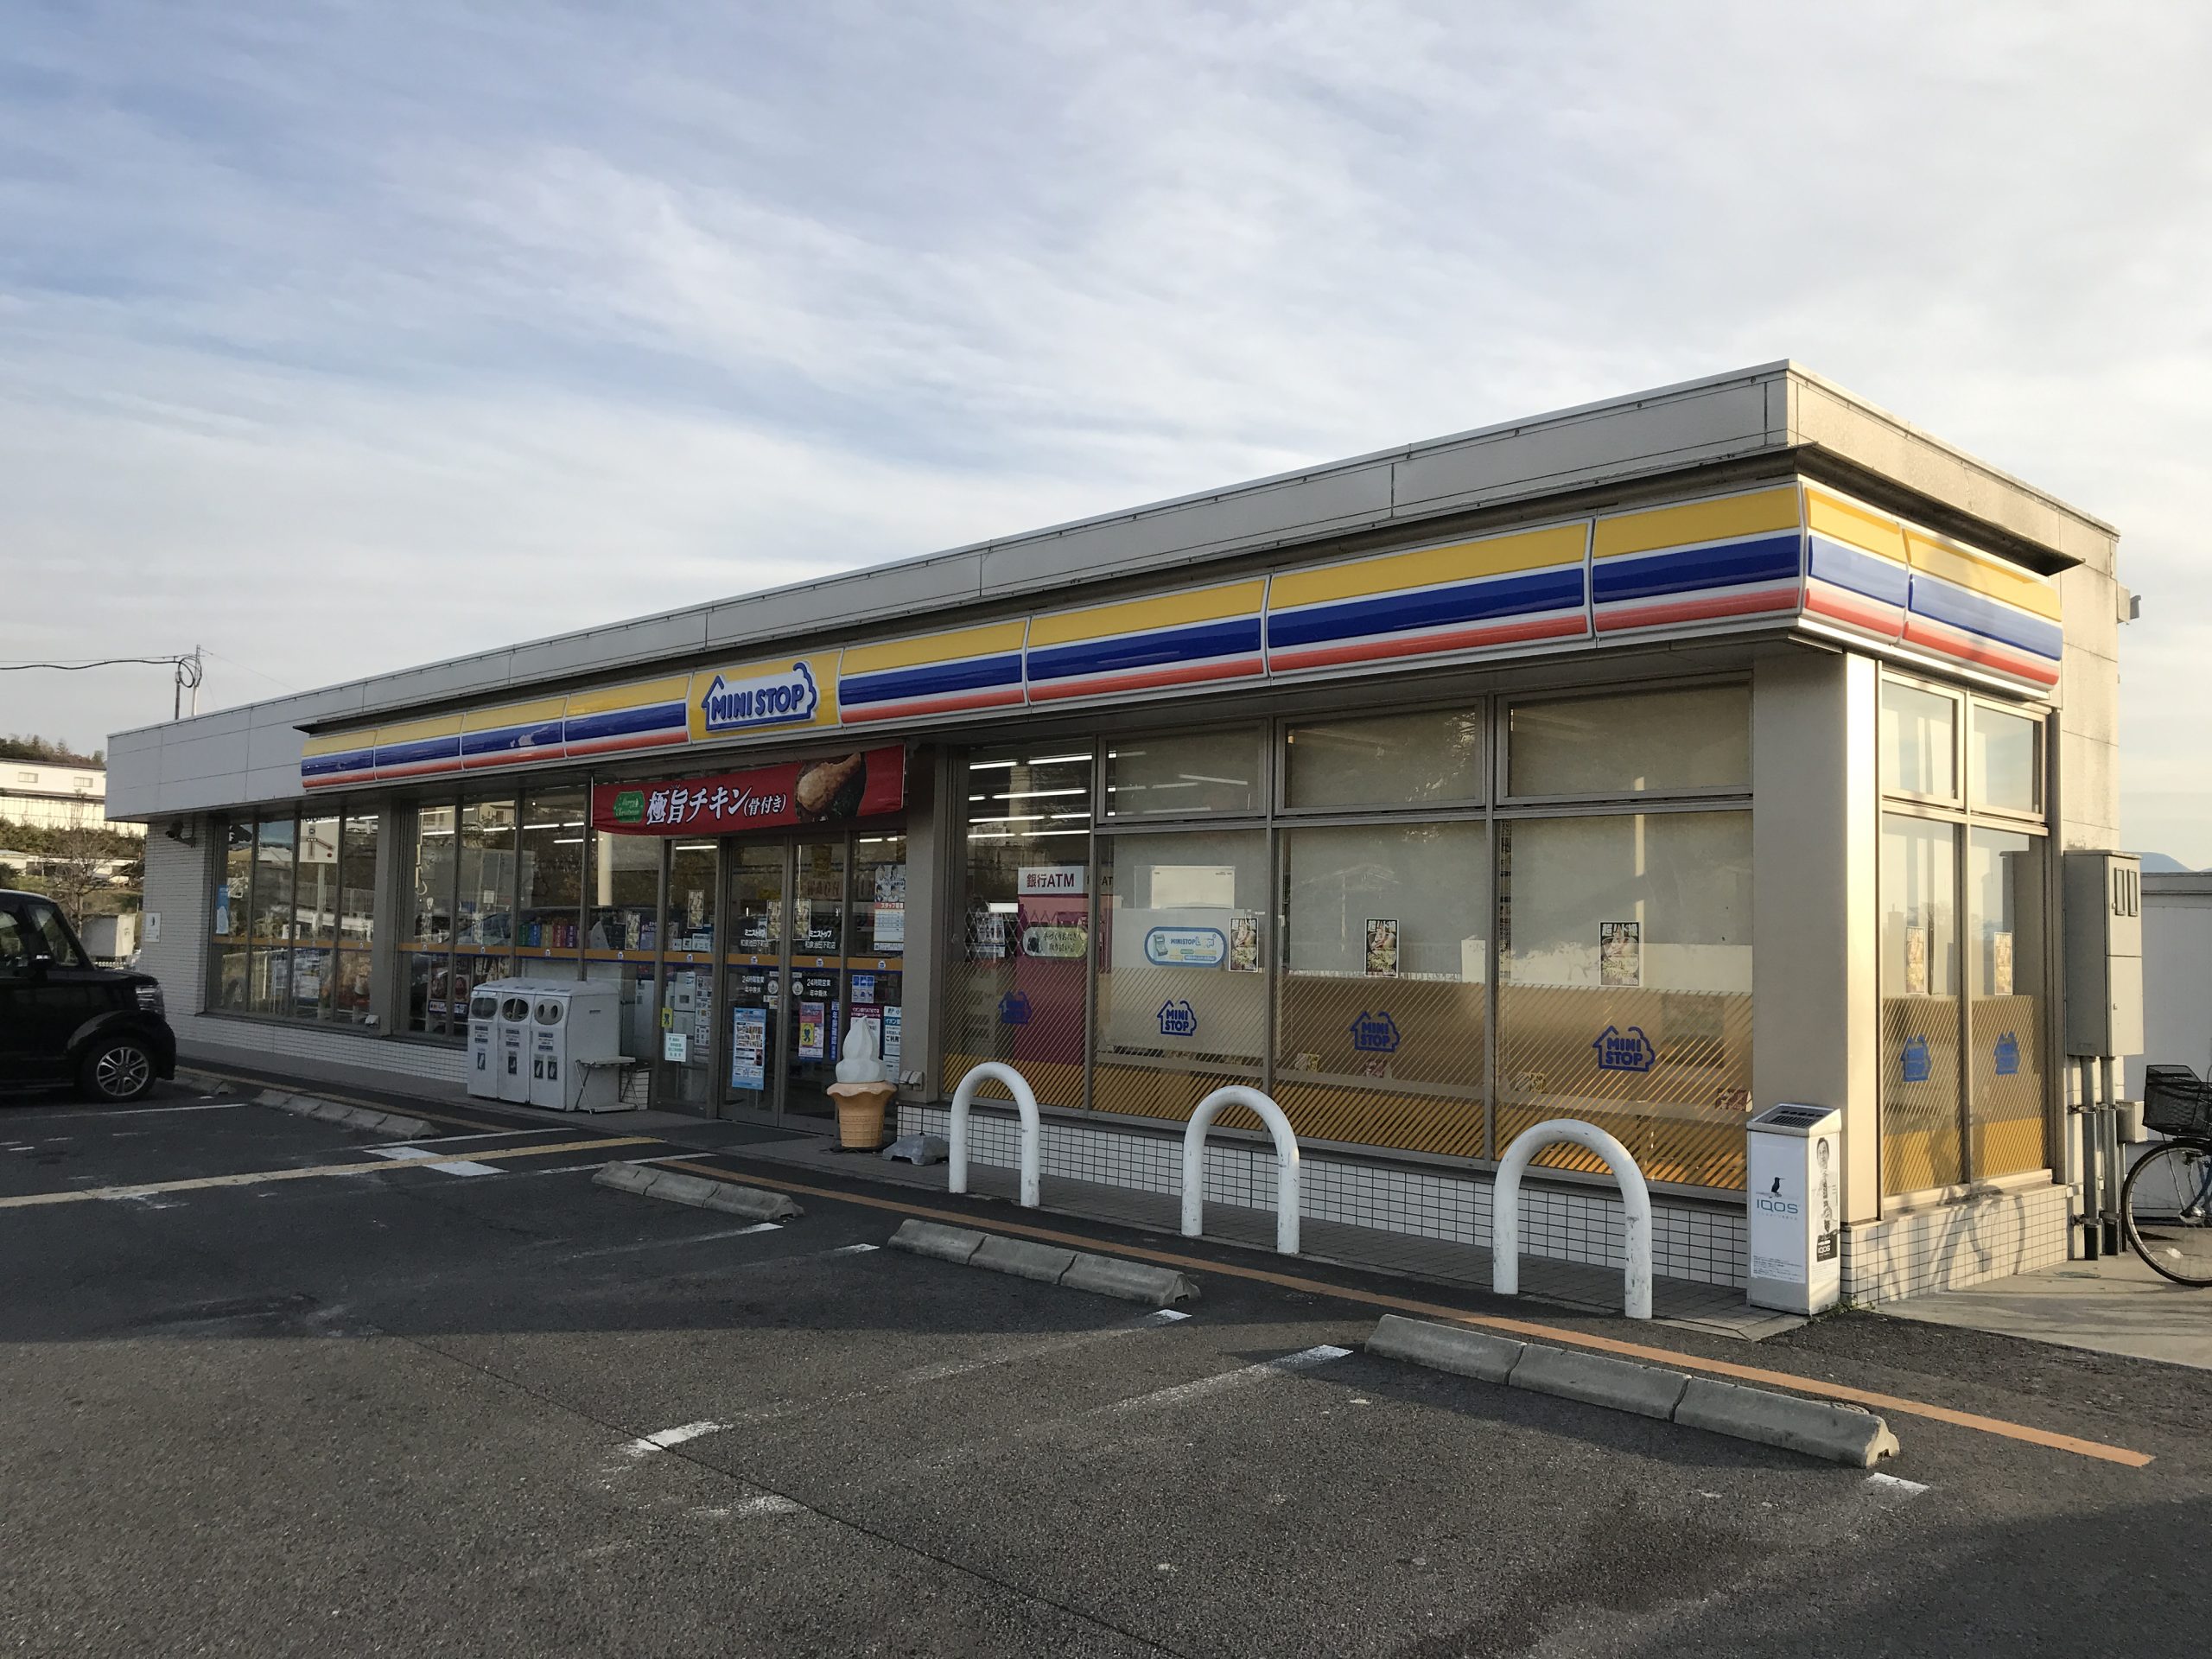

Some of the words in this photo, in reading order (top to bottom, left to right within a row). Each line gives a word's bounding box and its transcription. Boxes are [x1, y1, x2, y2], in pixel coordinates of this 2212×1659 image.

[711, 690, 752, 721] MINI
[755, 683, 805, 717] STOP
[1027, 874, 1075, 888] 銀行ATM
[1166, 1009, 1189, 1020] MINI
[1165, 1020, 1189, 1032] STOP
[1362, 1022, 1389, 1035] MINI
[1360, 1034, 1390, 1046] STOP
[1607, 1038, 1642, 1052] MINI
[1605, 1051, 1643, 1065] STOP
[1757, 1199, 1798, 1214] IQOS
